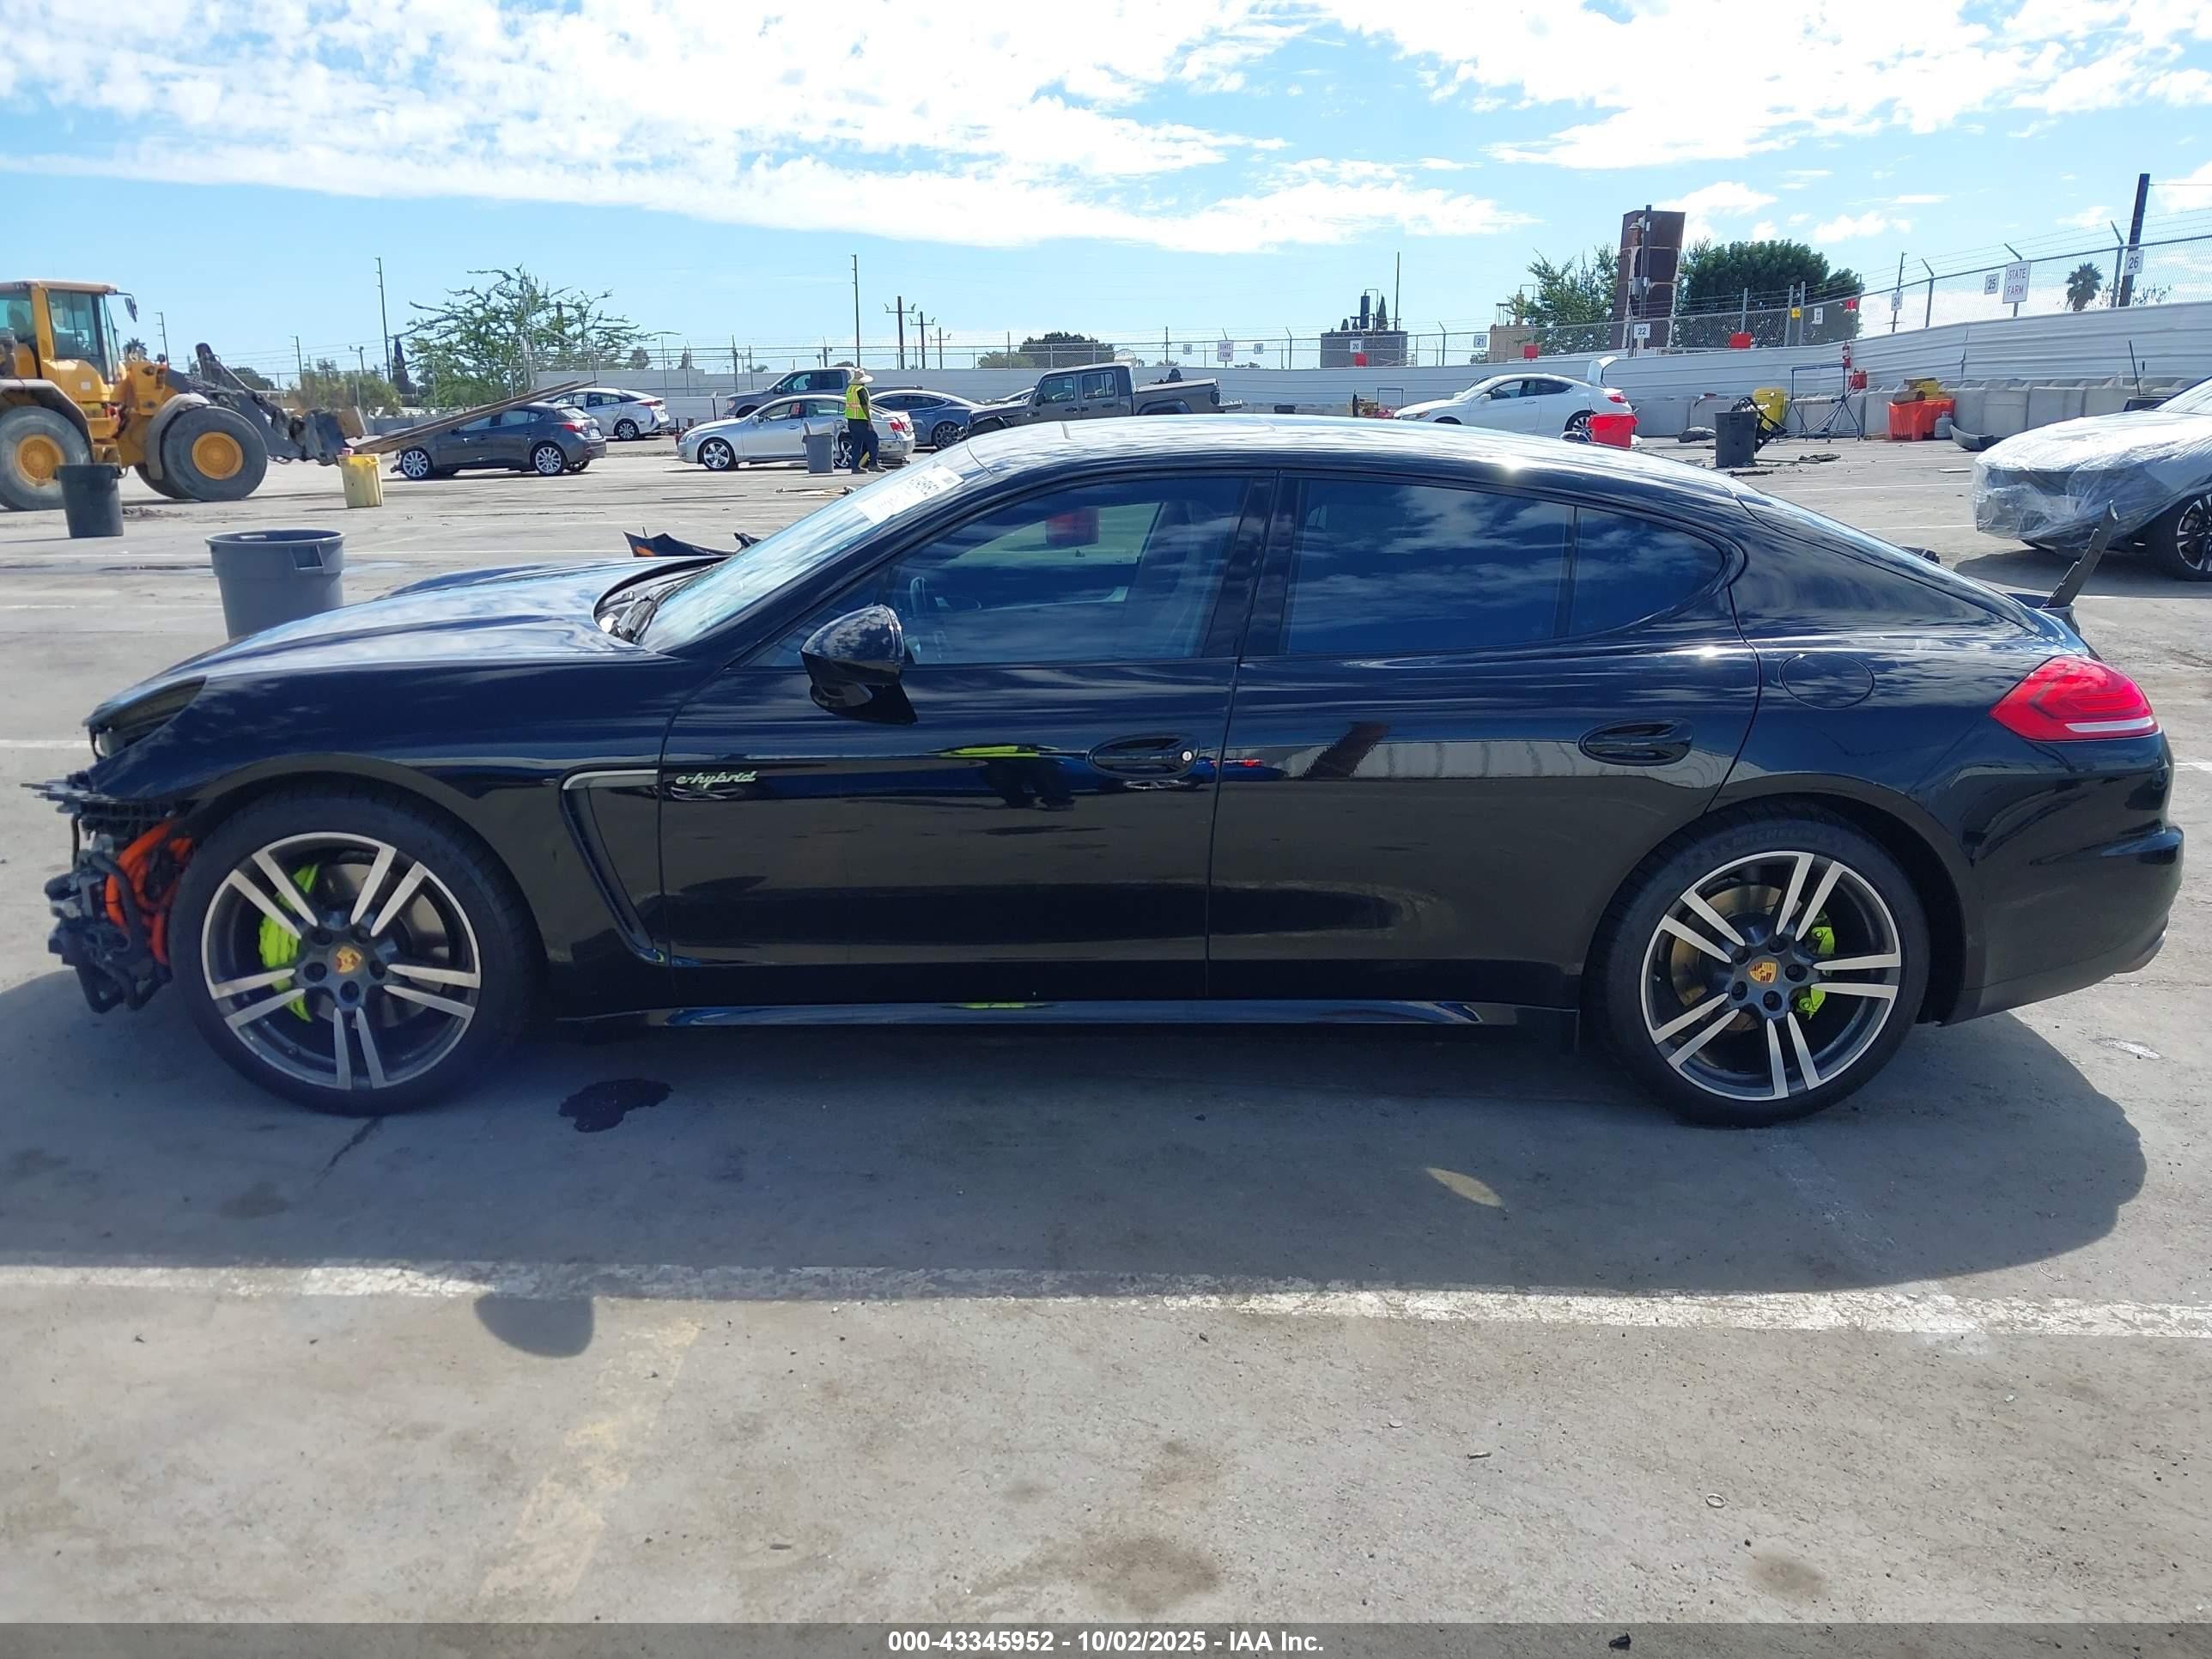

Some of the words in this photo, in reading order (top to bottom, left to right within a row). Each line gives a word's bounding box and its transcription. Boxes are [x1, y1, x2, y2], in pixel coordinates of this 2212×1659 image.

[2128, 256, 2140, 270] 26
[2008, 267, 2027, 280] STATE
[1987, 278, 1996, 290] 25
[2007, 284, 2025, 296] FARM
[1893, 296, 1901, 307] 24
[1638, 326, 1647, 336] 22
[675, 770, 757, 789] e-hybrid
